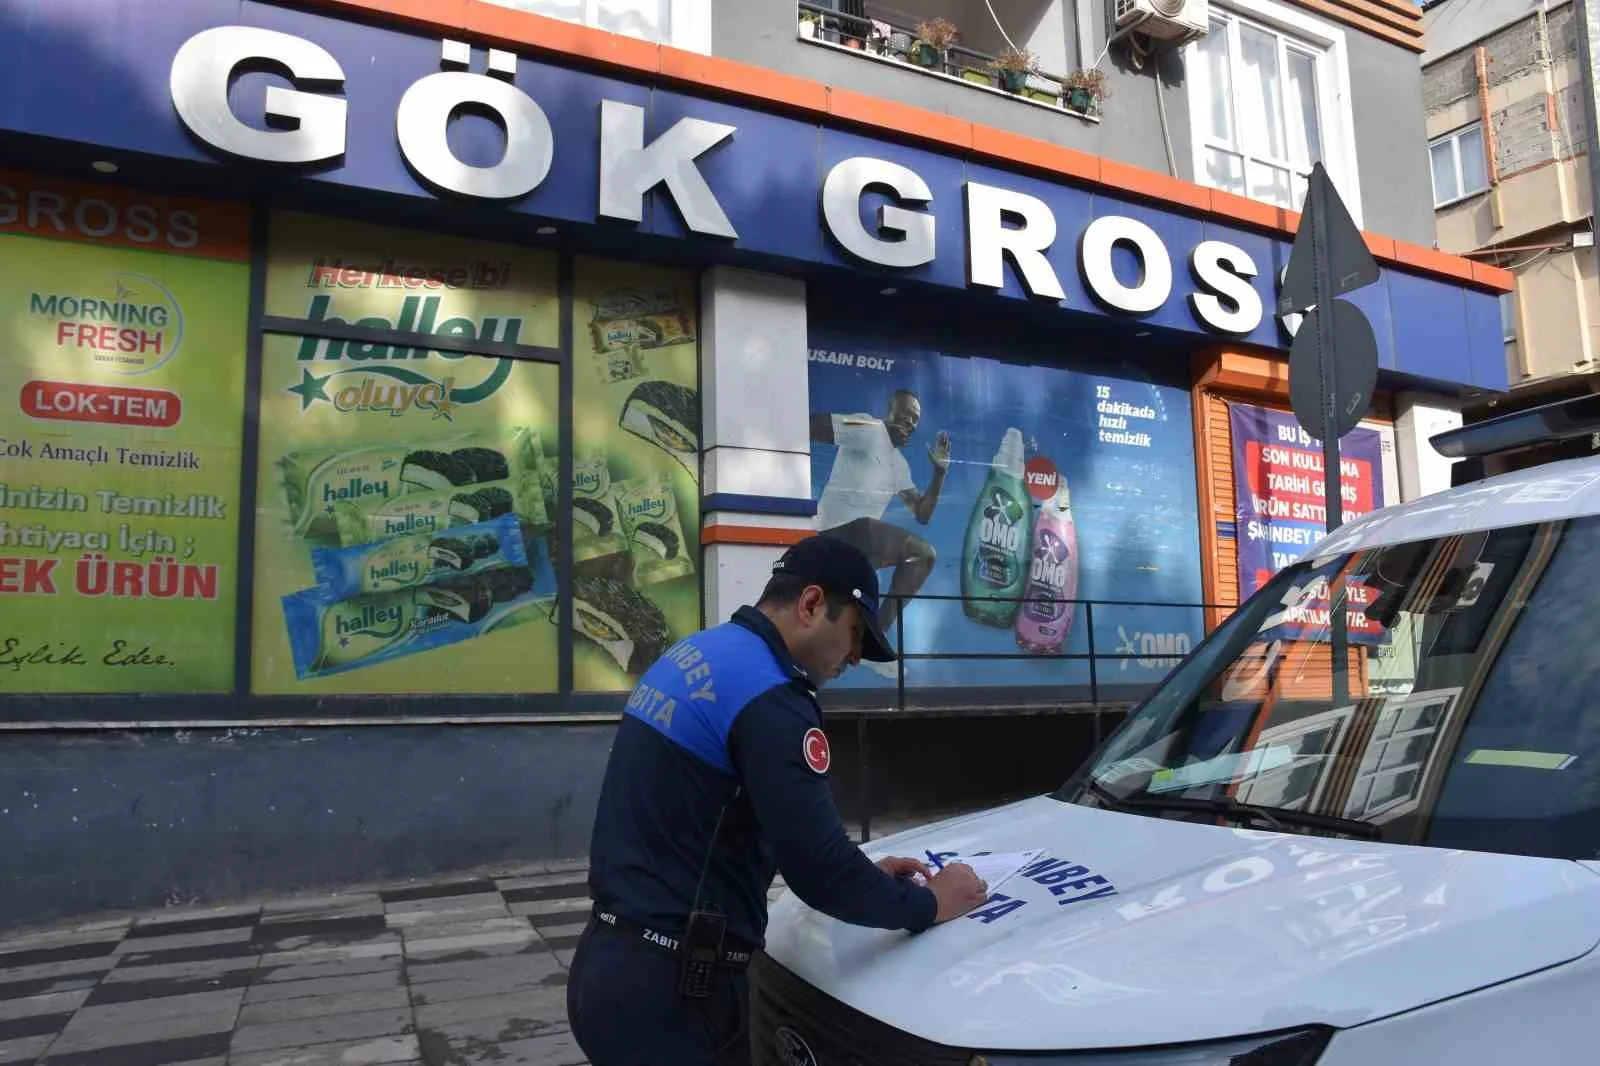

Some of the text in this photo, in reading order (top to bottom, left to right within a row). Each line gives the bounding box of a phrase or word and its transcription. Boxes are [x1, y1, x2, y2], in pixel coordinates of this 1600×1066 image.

[169, 25, 1318, 340] GÖK GROS
[308, 258, 467, 289] Herkese
[30, 292, 168, 327] MORNING
[57, 322, 163, 354] FRESH
[297, 295, 522, 404] halley
[807, 348, 894, 371] USAIN BOLT
[35, 389, 167, 419] LOK-TEM
[1096, 385, 1111, 399] 15
[1097, 400, 1156, 420] dakikada
[1099, 429, 1152, 447] temizlik
[1278, 424, 1296, 442] BU
[40, 442, 109, 466] Amaçlı
[116, 448, 200, 469] Temizlik
[1262, 447, 1360, 478] SON KULLMA
[323, 477, 389, 501] halley
[1027, 471, 1056, 487] YENİ
[1267, 472, 1310, 494] TARİHİ
[96, 490, 226, 519] Temizlik
[0, 520, 110, 553] htiyacı
[384, 513, 436, 533] halley
[982, 519, 1020, 551] OMO
[0, 553, 218, 599] EK ÜRÜN
[370, 559, 420, 582] halley
[1031, 557, 1066, 588] OMO
[1308, 580, 1367, 602] SÜYLE
[335, 602, 403, 634] halley
[629, 683, 678, 729] BITA
[642, 927, 680, 951] ZABIT
